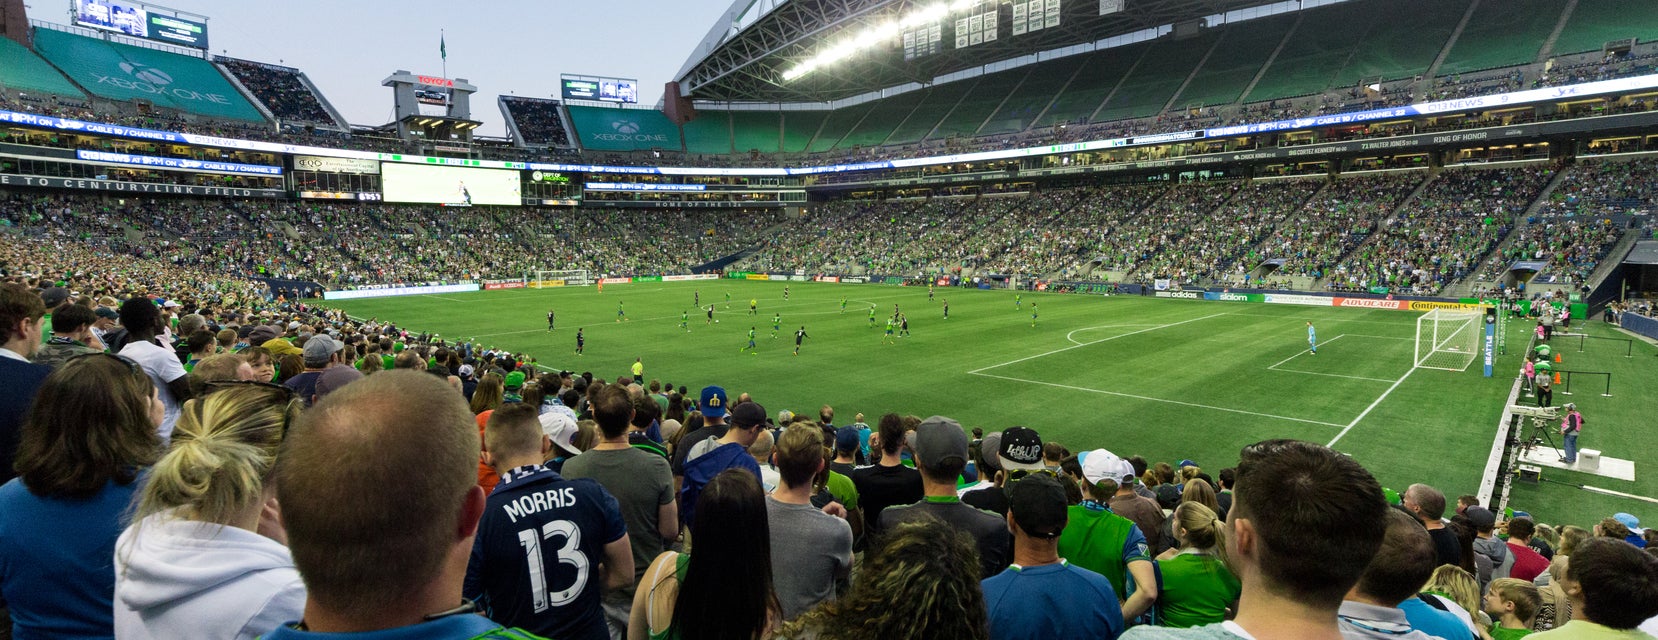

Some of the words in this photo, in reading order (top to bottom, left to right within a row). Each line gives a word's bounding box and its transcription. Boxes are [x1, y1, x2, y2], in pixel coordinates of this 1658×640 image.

[417, 75, 453, 87] TOYOTA
[172, 88, 232, 104] ONE
[1449, 98, 1484, 110] NEWS
[11, 112, 36, 124] 9PM
[39, 118, 52, 126] ON
[86, 124, 112, 134] CABLE
[129, 130, 164, 140] CHANNEL
[1223, 126, 1248, 135] NEWS
[1258, 122, 1278, 131] 9PM
[1317, 116, 1340, 124] CABLE
[1357, 111, 1394, 120] CHANNEL
[211, 137, 237, 147] NEWS
[594, 132, 633, 141] XBOX
[634, 134, 668, 142] ONE
[1433, 135, 1451, 143] RING
[1462, 132, 1488, 140] HONOR
[100, 152, 130, 163] NEWS
[142, 156, 164, 165] 9PM
[24, 177, 48, 186] TO
[64, 180, 193, 194] CENTURYLINK
[205, 188, 251, 196] FIELD
[1342, 299, 1399, 309] ADVOCARE
[503, 487, 576, 523] MORRIS
[518, 519, 590, 614] 13
